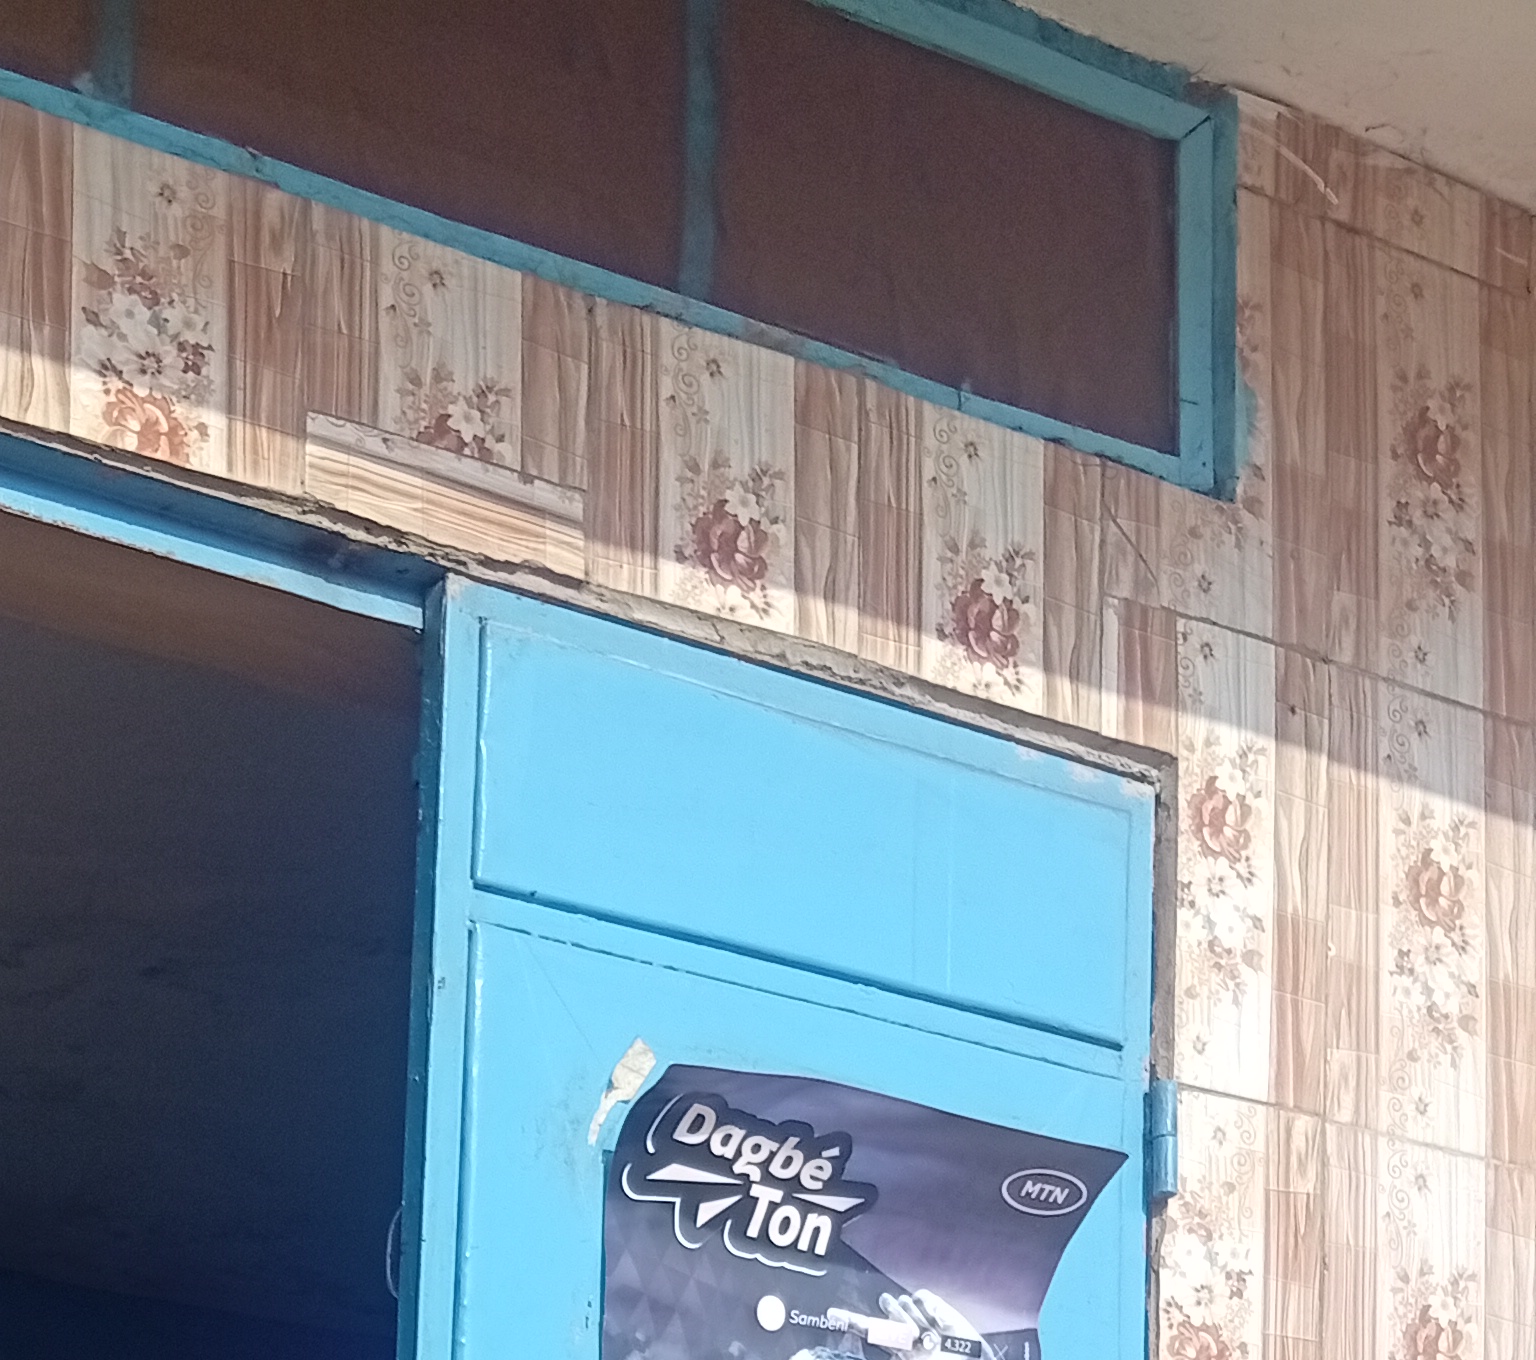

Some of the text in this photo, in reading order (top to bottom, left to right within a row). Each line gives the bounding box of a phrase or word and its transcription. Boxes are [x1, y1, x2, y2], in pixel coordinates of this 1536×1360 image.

[671, 1102, 841, 1191] Dagbé
[745, 1184, 834, 1257] Ton
[1020, 1179, 1071, 1205] MTN
